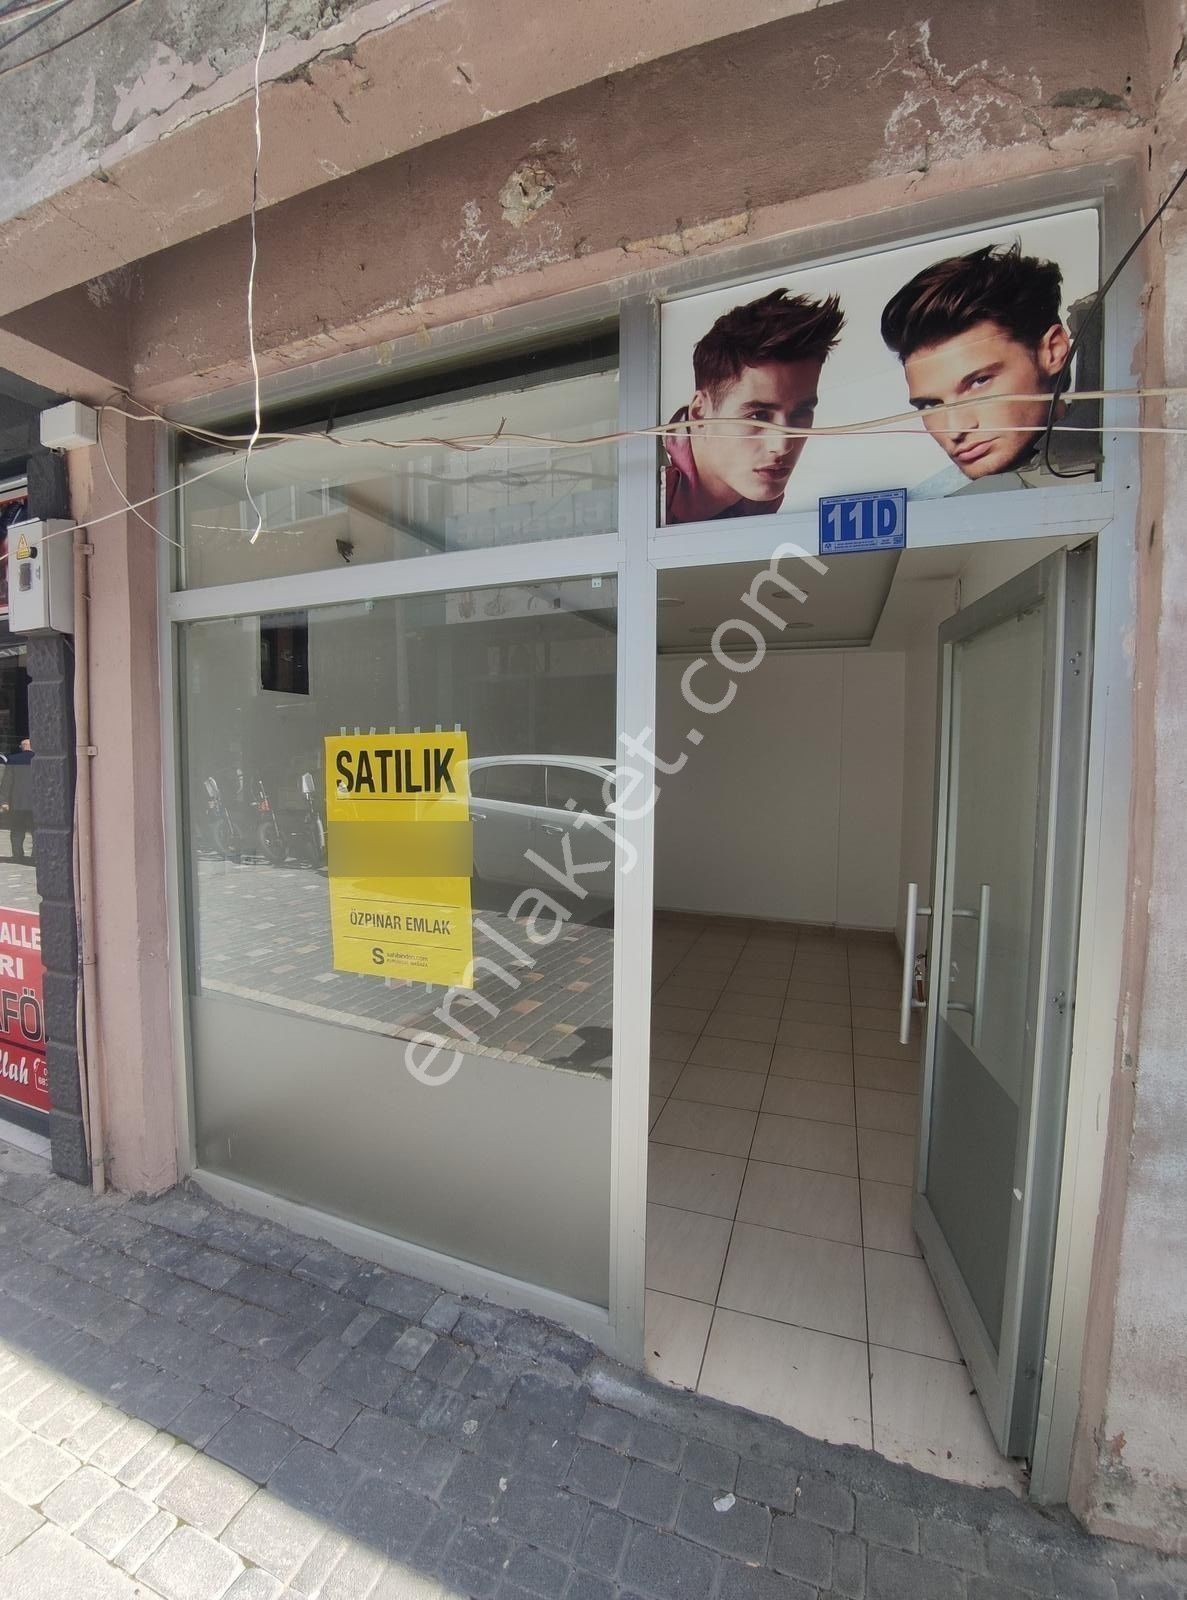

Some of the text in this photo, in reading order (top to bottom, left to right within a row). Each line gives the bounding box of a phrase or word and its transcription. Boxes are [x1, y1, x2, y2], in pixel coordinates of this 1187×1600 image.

[336, 747, 456, 794] SATILIK
[350, 908, 451, 936] ÖZPINAR EMLAK
[0, 987, 48, 1044] FÖ
